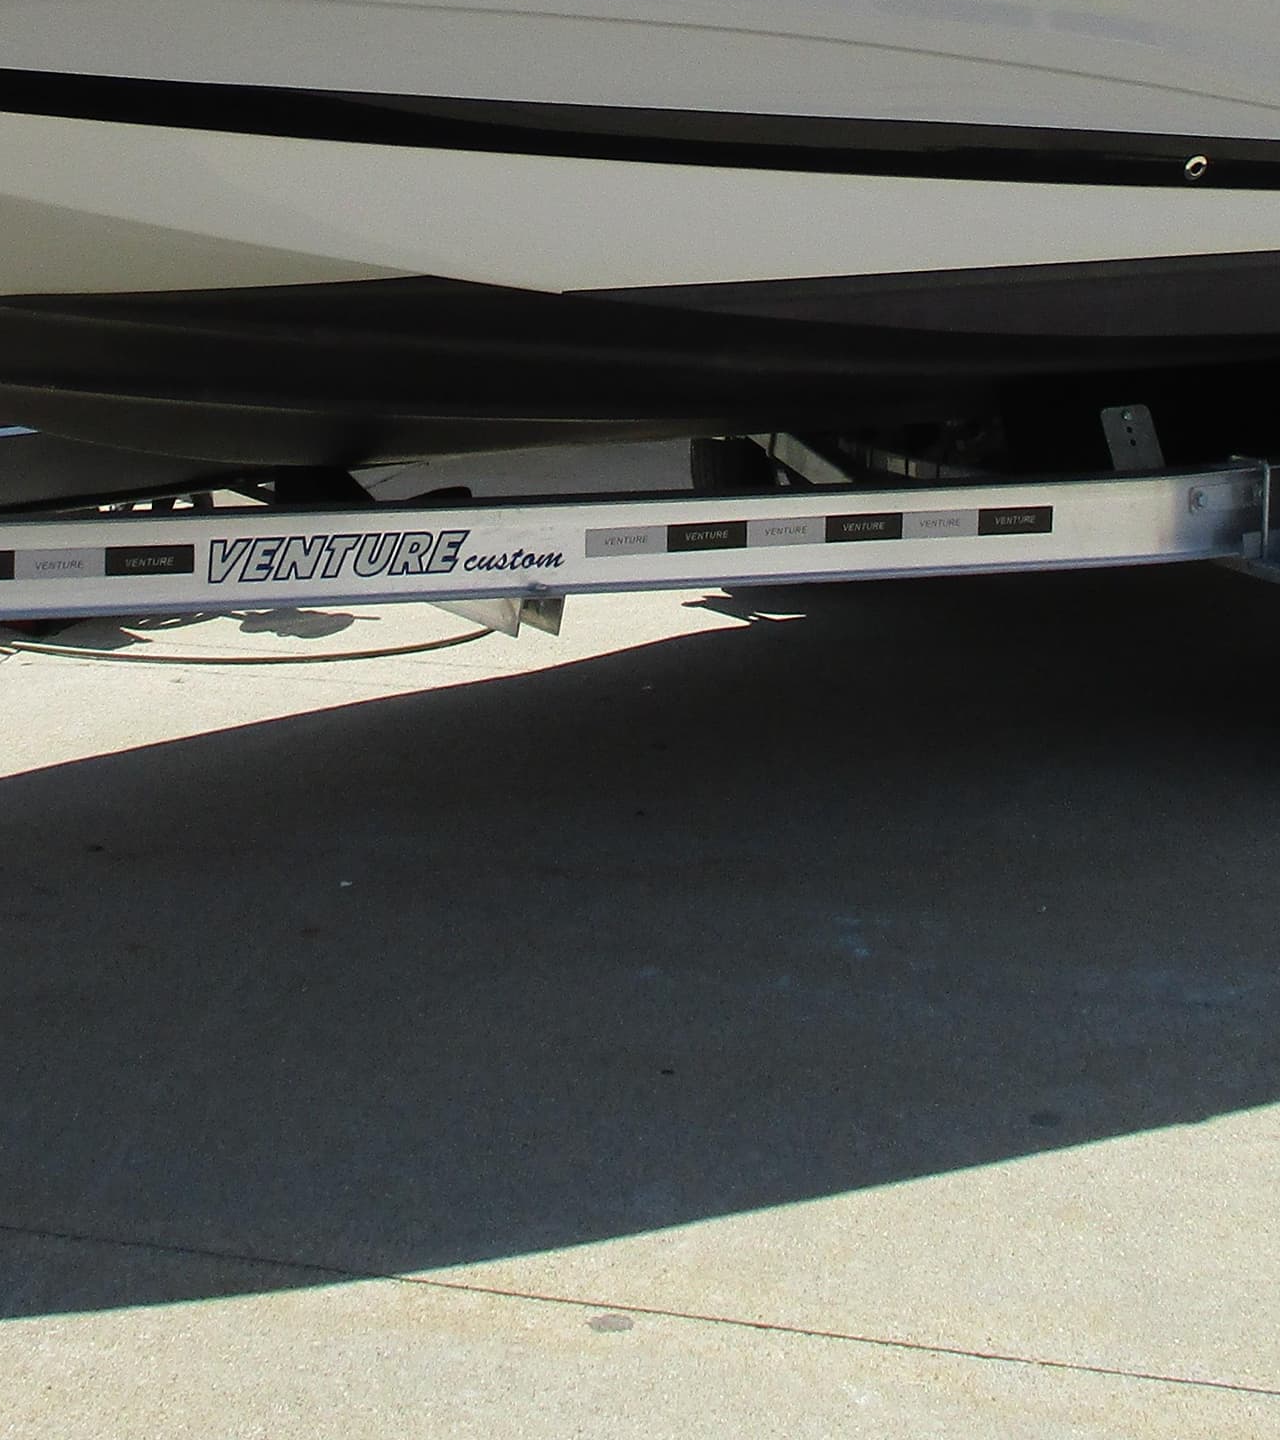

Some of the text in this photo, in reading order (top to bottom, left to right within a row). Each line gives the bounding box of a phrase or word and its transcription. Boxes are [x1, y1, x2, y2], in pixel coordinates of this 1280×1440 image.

[919, 517, 961, 528] VENTURE
[993, 514, 1037, 525] VENTURE
[764, 526, 808, 536] VENTURE
[842, 521, 886, 532] VENTURE
[604, 535, 649, 546] VENTURE
[684, 530, 729, 541] VENTURE
[124, 556, 175, 568] VENTURE
[207, 530, 565, 584] VENTURE custom
[35, 559, 85, 570] VENTURE
